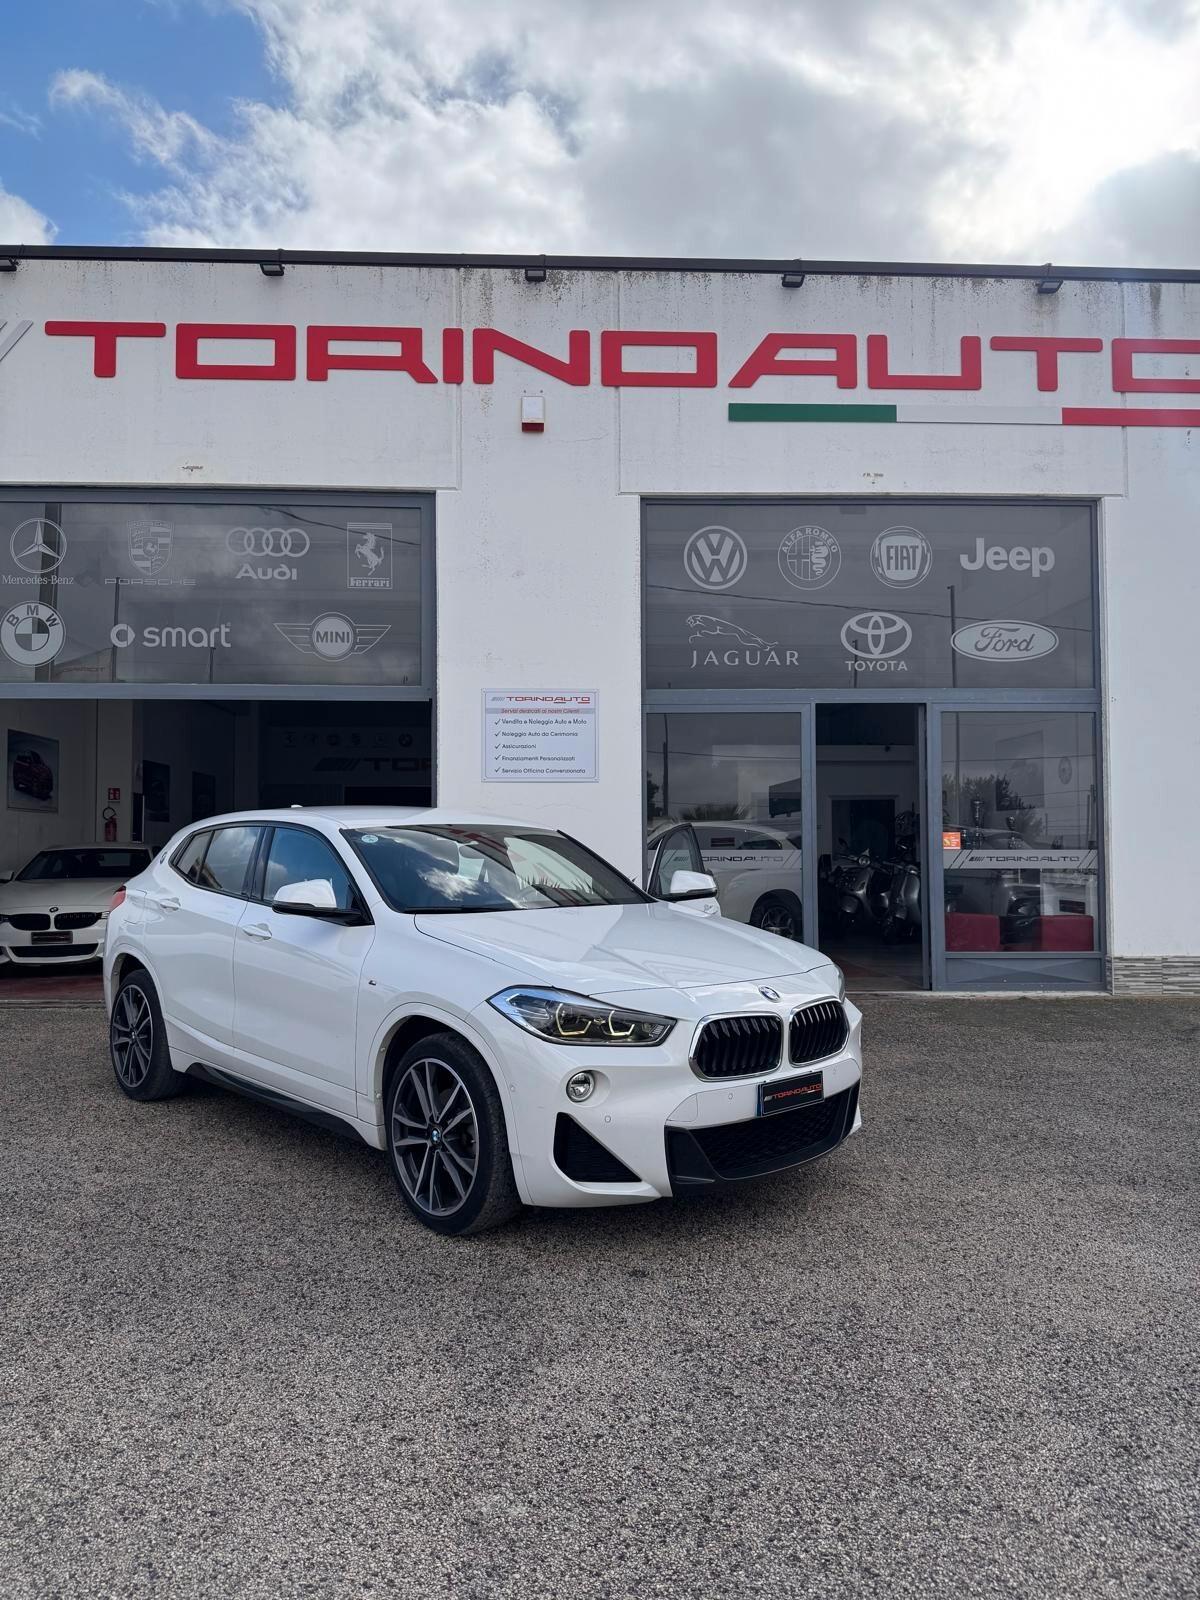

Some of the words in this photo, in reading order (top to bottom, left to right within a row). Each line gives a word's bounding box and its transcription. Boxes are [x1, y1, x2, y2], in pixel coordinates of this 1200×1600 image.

[45, 320, 1200, 393] TORINOAUTO
[782, 530, 803, 554] ALFA
[805, 527, 838, 553] ROMEO
[886, 544, 918, 572] FIAT
[960, 537, 1055, 577] Jeep
[2, 574, 75, 585] Mercedes-Benz
[236, 563, 298, 581] Audi
[104, 578, 197, 586] PORSCHE
[350, 577, 390, 588] Ferrari
[6, 604, 61, 628] BMW
[142, 623, 231, 649] smart
[315, 630, 351, 644] MINI
[974, 627, 1035, 653] Ford
[690, 649, 799, 668] JAGUAR
[845, 660, 908, 671] TOYOTA
[774, 1083, 822, 1098] TORINOAUTO
